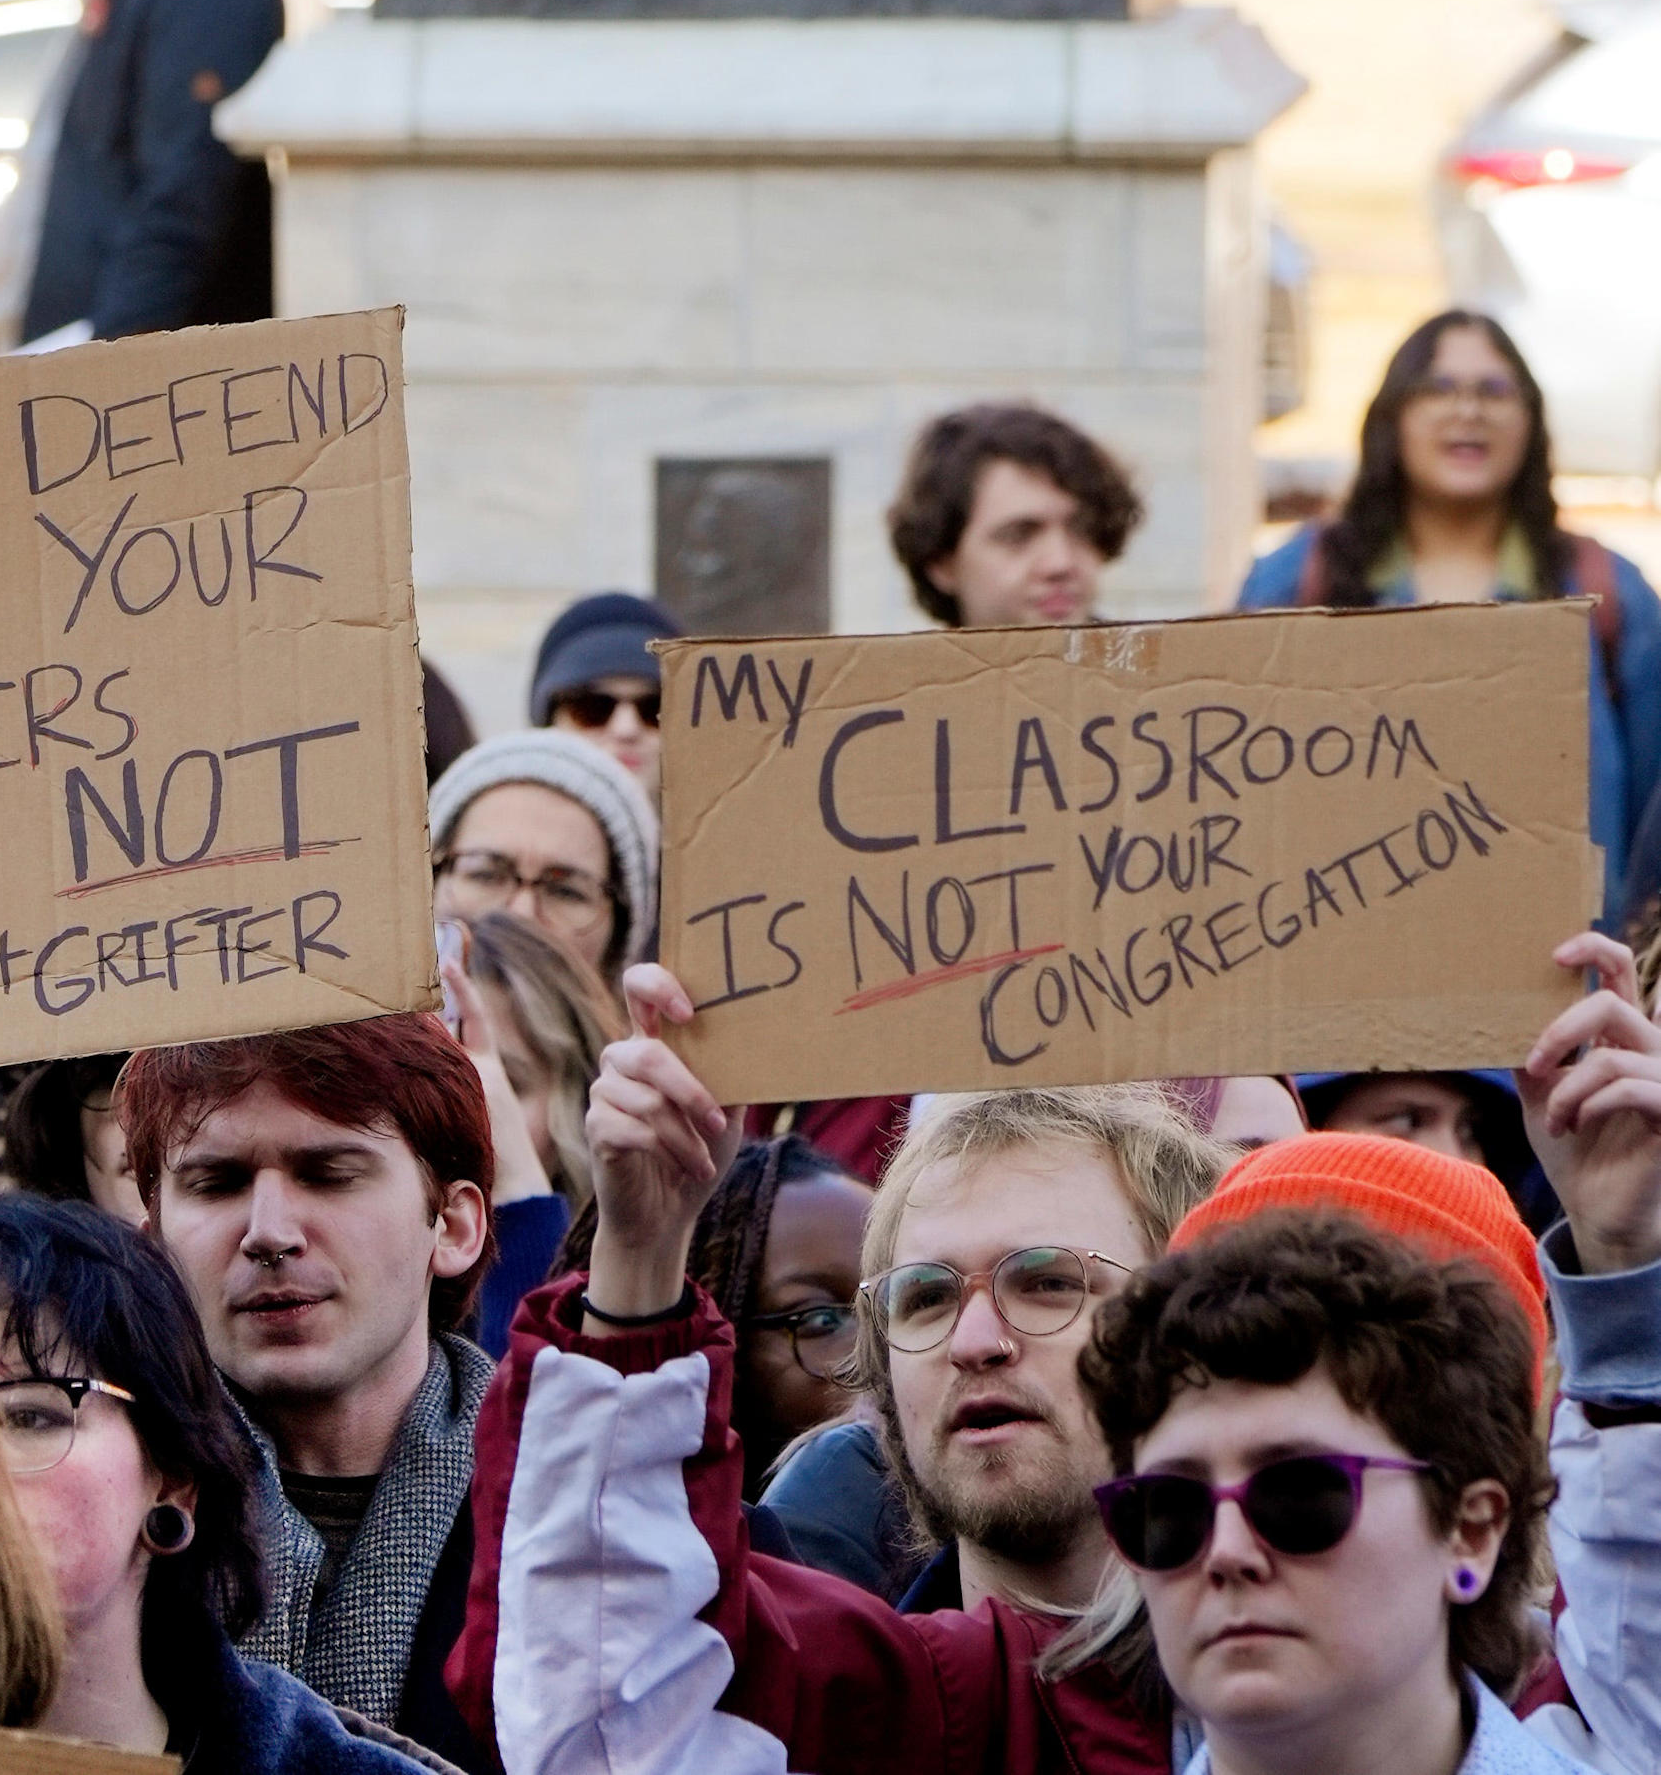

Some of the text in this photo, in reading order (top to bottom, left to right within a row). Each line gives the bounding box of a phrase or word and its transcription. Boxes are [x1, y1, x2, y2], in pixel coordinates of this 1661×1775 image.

[18, 353, 390, 495] DEFEND
[34, 485, 323, 634] YOUR
[65, 721, 361, 883] NOT
[818, 705, 1439, 853] CLASSROOM
[34, 890, 350, 1016] GRIFTER
[686, 815, 1251, 1012] IS NOT YOUR
[979, 780, 1508, 1067] CONGREGATION
